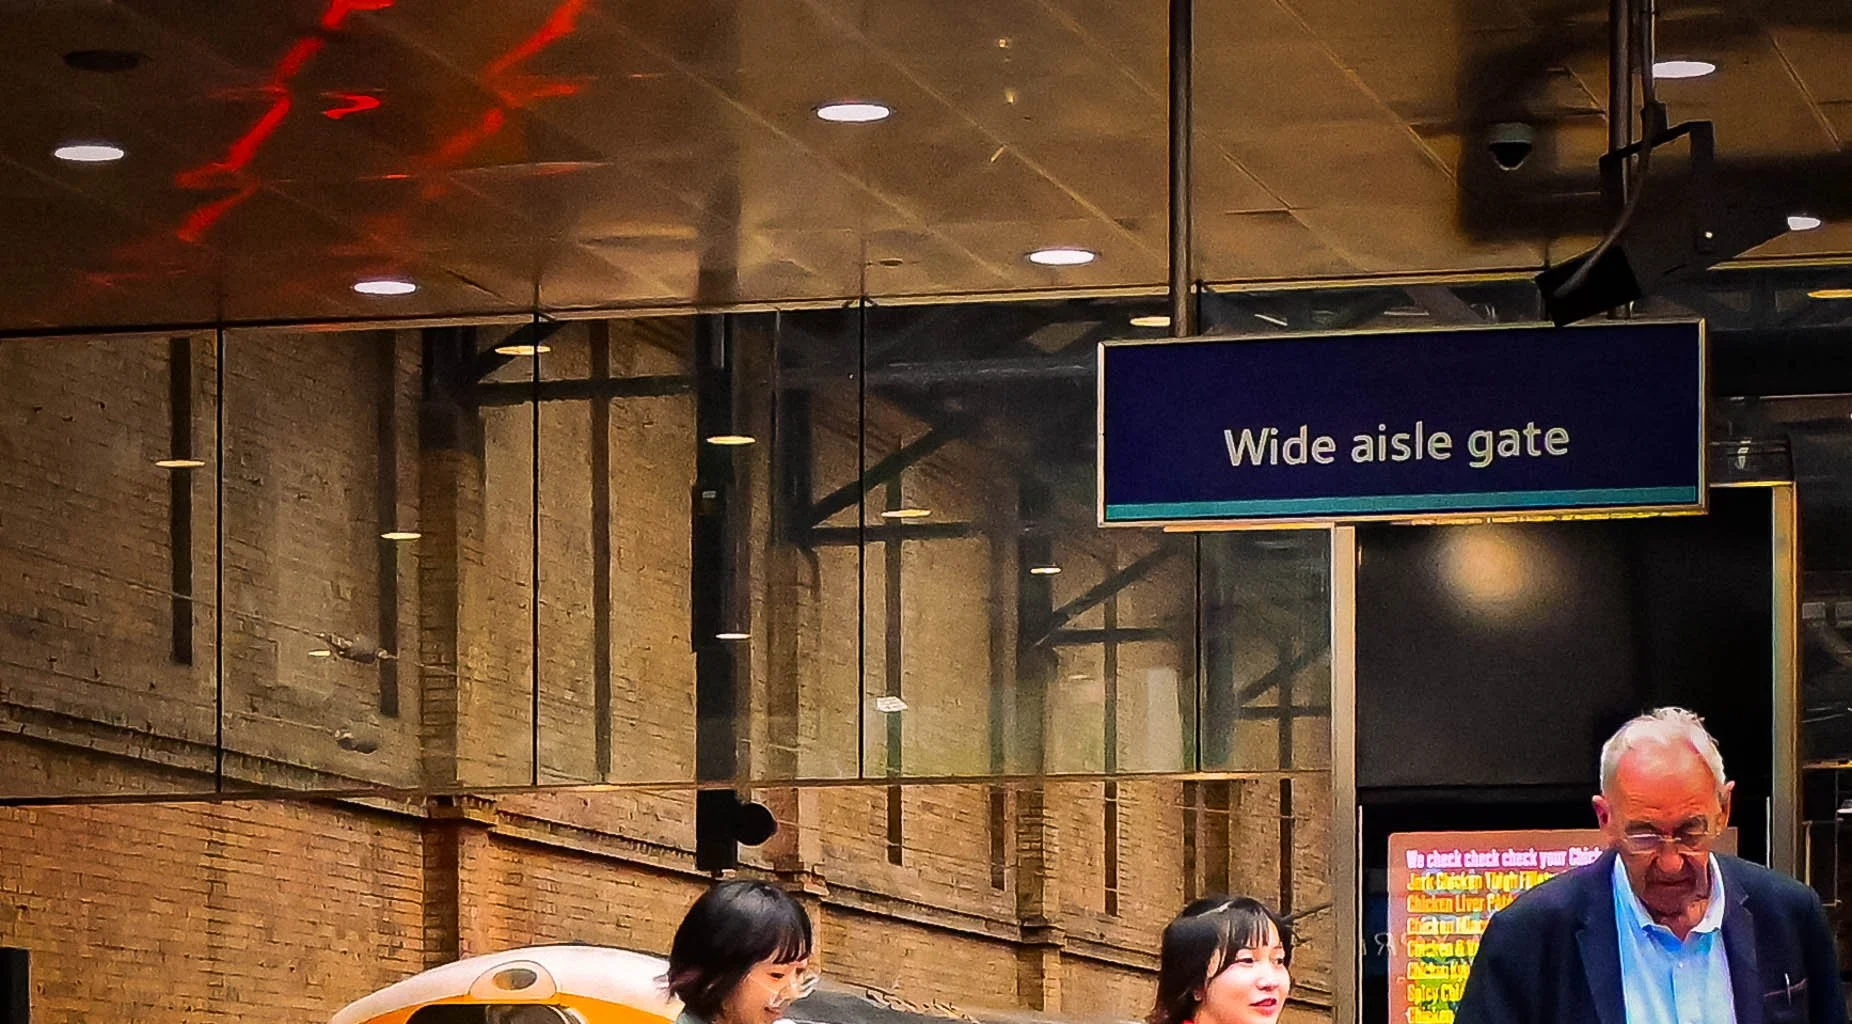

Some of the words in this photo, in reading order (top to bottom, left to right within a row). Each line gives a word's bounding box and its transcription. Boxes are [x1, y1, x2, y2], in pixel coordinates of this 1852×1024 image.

[1224, 425, 1336, 466] Wide
[1351, 421, 1452, 463] aisle
[1468, 422, 1570, 468] gate
[1406, 850, 1424, 868] We
[1427, 849, 1462, 867] check
[1464, 849, 1500, 867] check
[1502, 848, 1538, 867] check
[1539, 851, 1567, 869] your
[1407, 894, 1453, 912] Chicken
[1455, 894, 1484, 912] Liver
[1407, 983, 1439, 1004] Spicy
